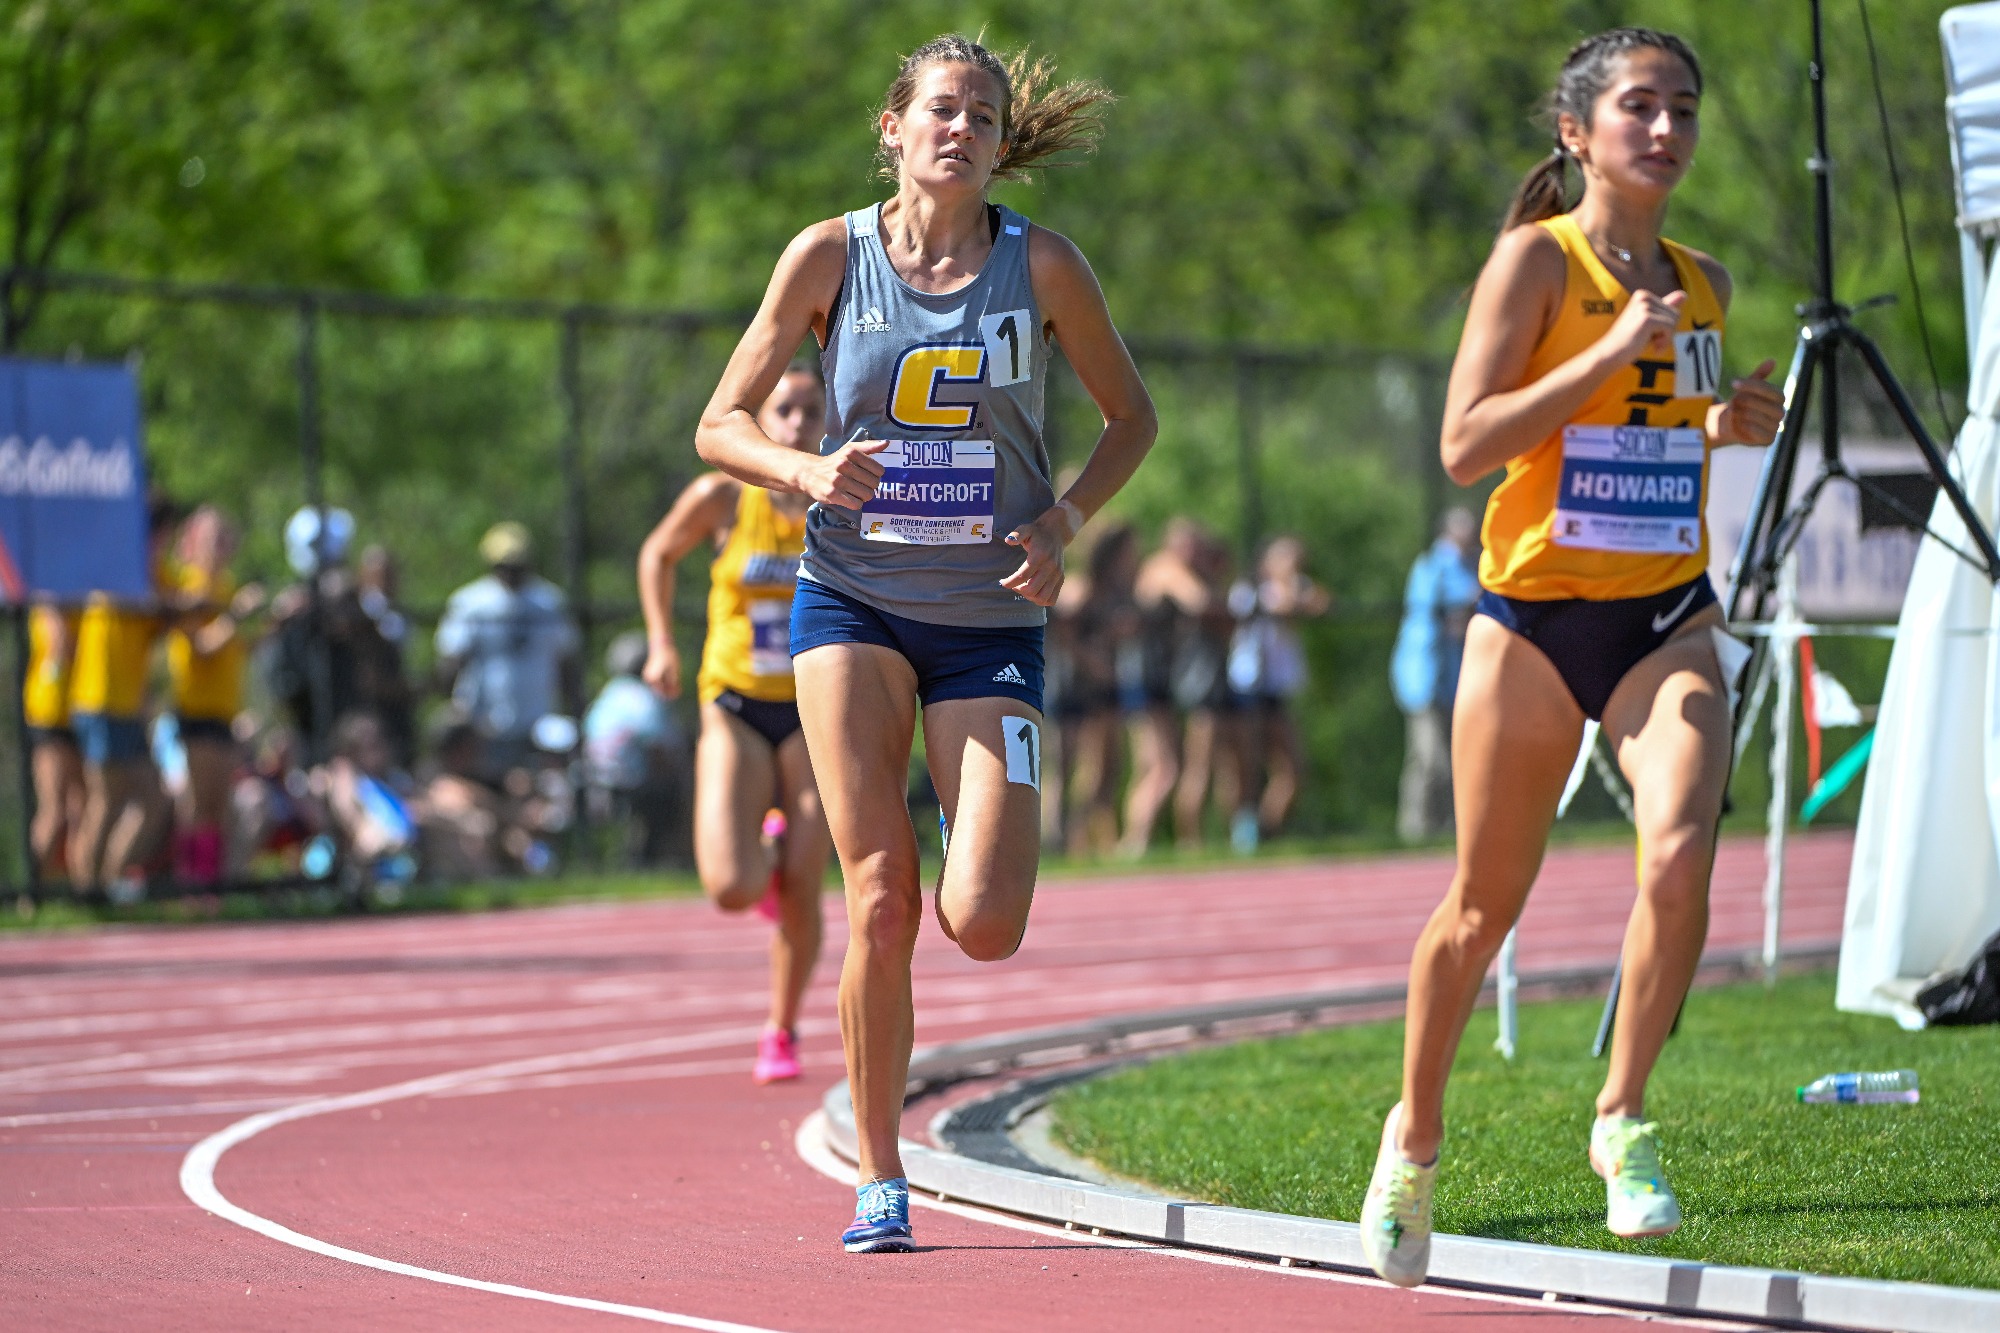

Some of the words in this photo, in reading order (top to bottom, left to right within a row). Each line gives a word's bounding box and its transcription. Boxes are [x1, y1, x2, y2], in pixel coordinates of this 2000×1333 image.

[853, 323, 891, 333] adidas
[996, 315, 1018, 380] 1
[1685, 334, 1717, 392] 10
[886, 341, 988, 432] C
[902, 440, 953, 467] SOCON
[1570, 471, 1694, 504] HOWARD
[890, 518, 923, 527] SOUTHERN
[925, 520, 965, 528] CONFERENCE
[993, 674, 1026, 685] adidas
[1016, 723, 1036, 785] 1
